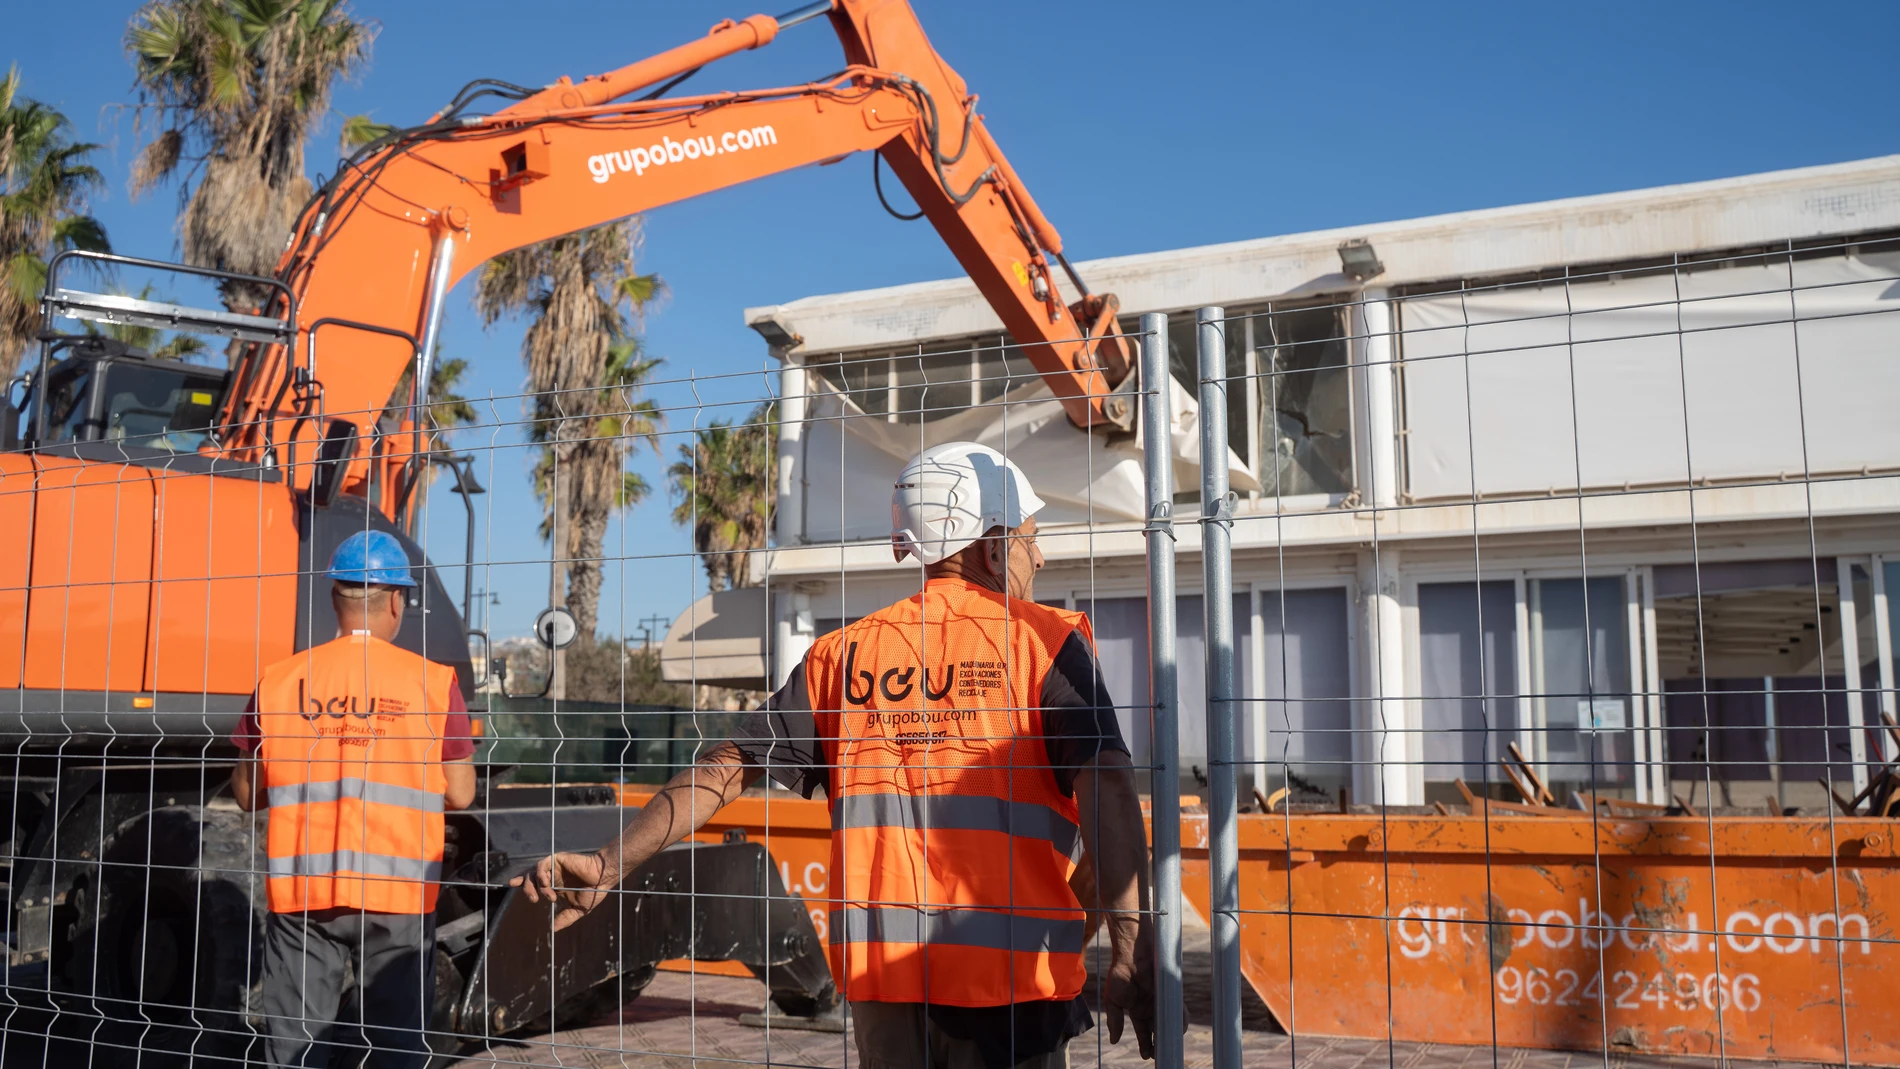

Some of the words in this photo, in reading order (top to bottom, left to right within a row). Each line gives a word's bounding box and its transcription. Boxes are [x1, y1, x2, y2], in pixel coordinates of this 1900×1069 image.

[588, 125, 777, 183] grupobou.com
[844, 642, 954, 705] bou
[960, 670, 1001, 679] EXCAVACIONES
[959, 679, 1001, 689] CONTENEDORES
[958, 688, 987, 698] RECICLAJE
[868, 709, 977, 728] grupobou.com
[318, 723, 386, 736] grupbou.cm
[1497, 967, 1761, 1011] 962424966
